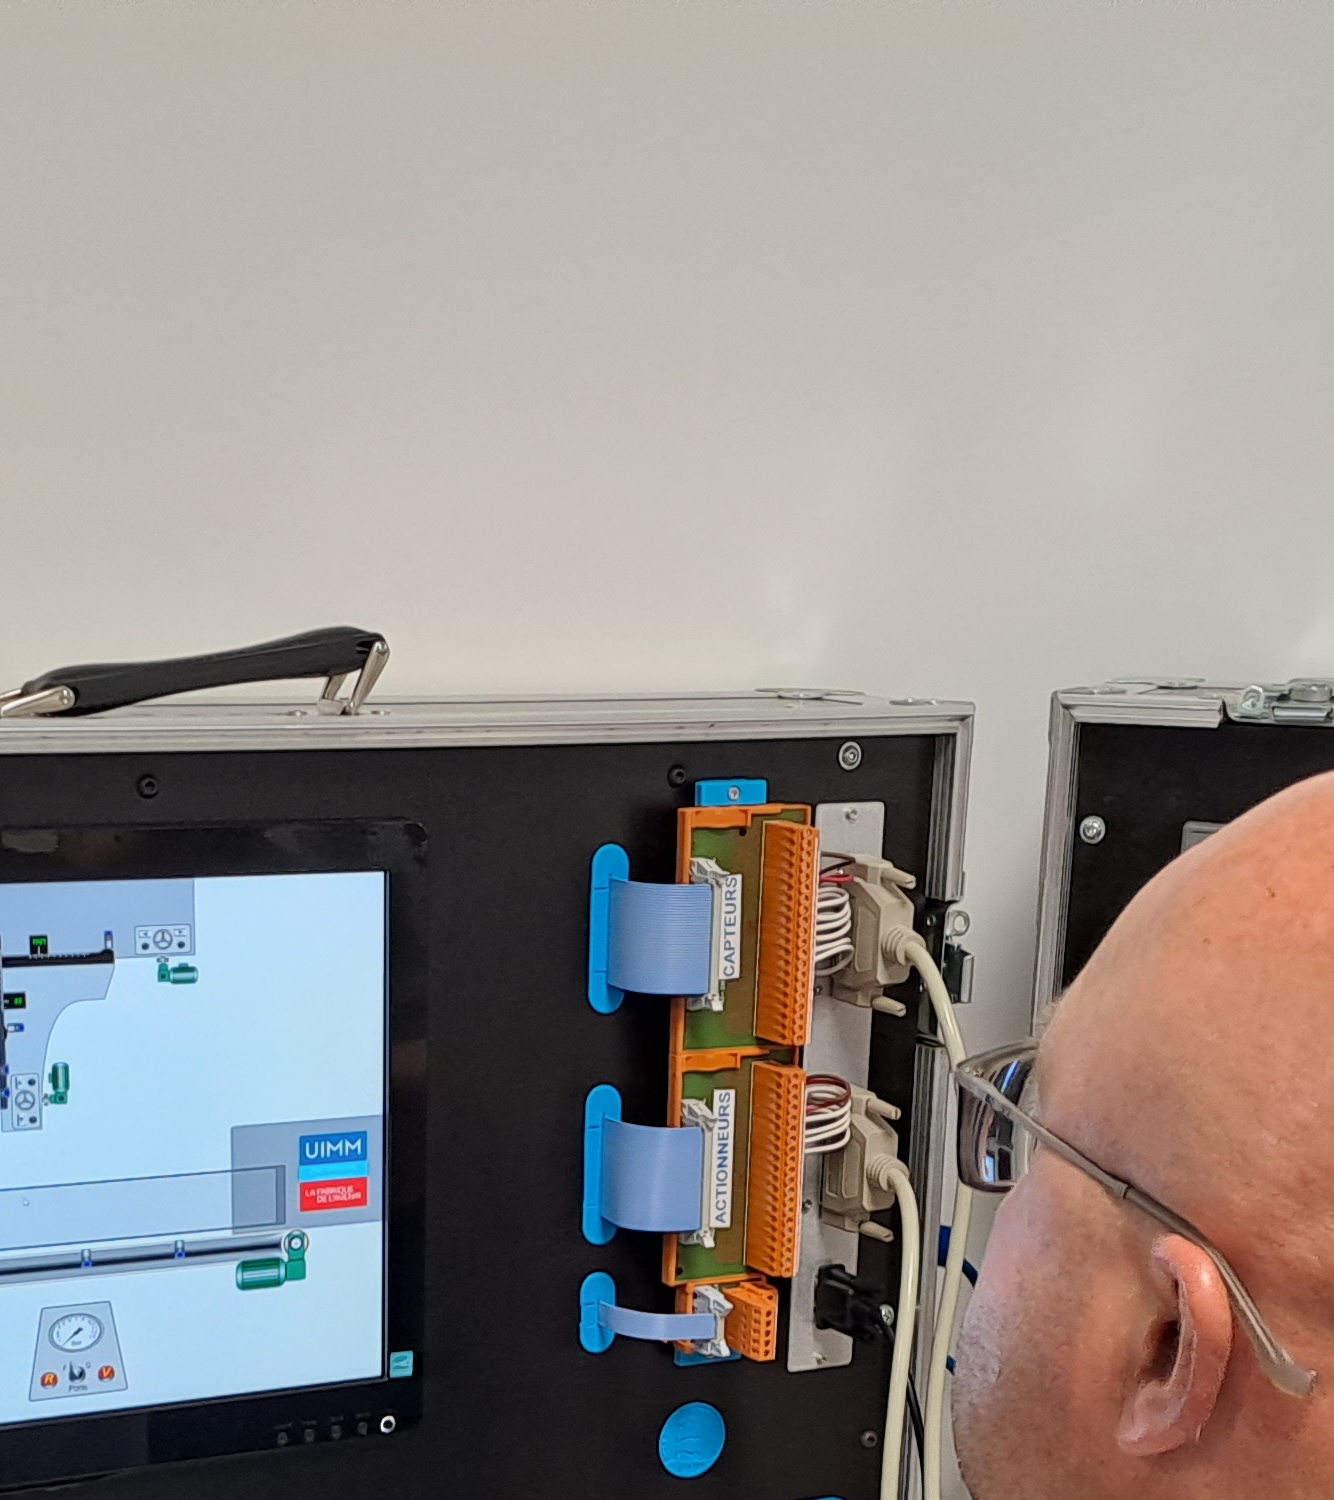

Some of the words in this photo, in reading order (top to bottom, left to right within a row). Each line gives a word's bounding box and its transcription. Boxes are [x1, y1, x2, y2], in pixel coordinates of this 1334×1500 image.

[723, 877, 737, 977] CAPTEURS
[305, 1138, 362, 1159] UIMM
[715, 1091, 731, 1223] ACTIONNEURS
[305, 1189, 315, 1198] LA
[316, 1185, 354, 1197] FABRIQUE
[316, 1195, 327, 1204] DE
[102, 1367, 112, 1378] V
[44, 1374, 54, 1385] R
